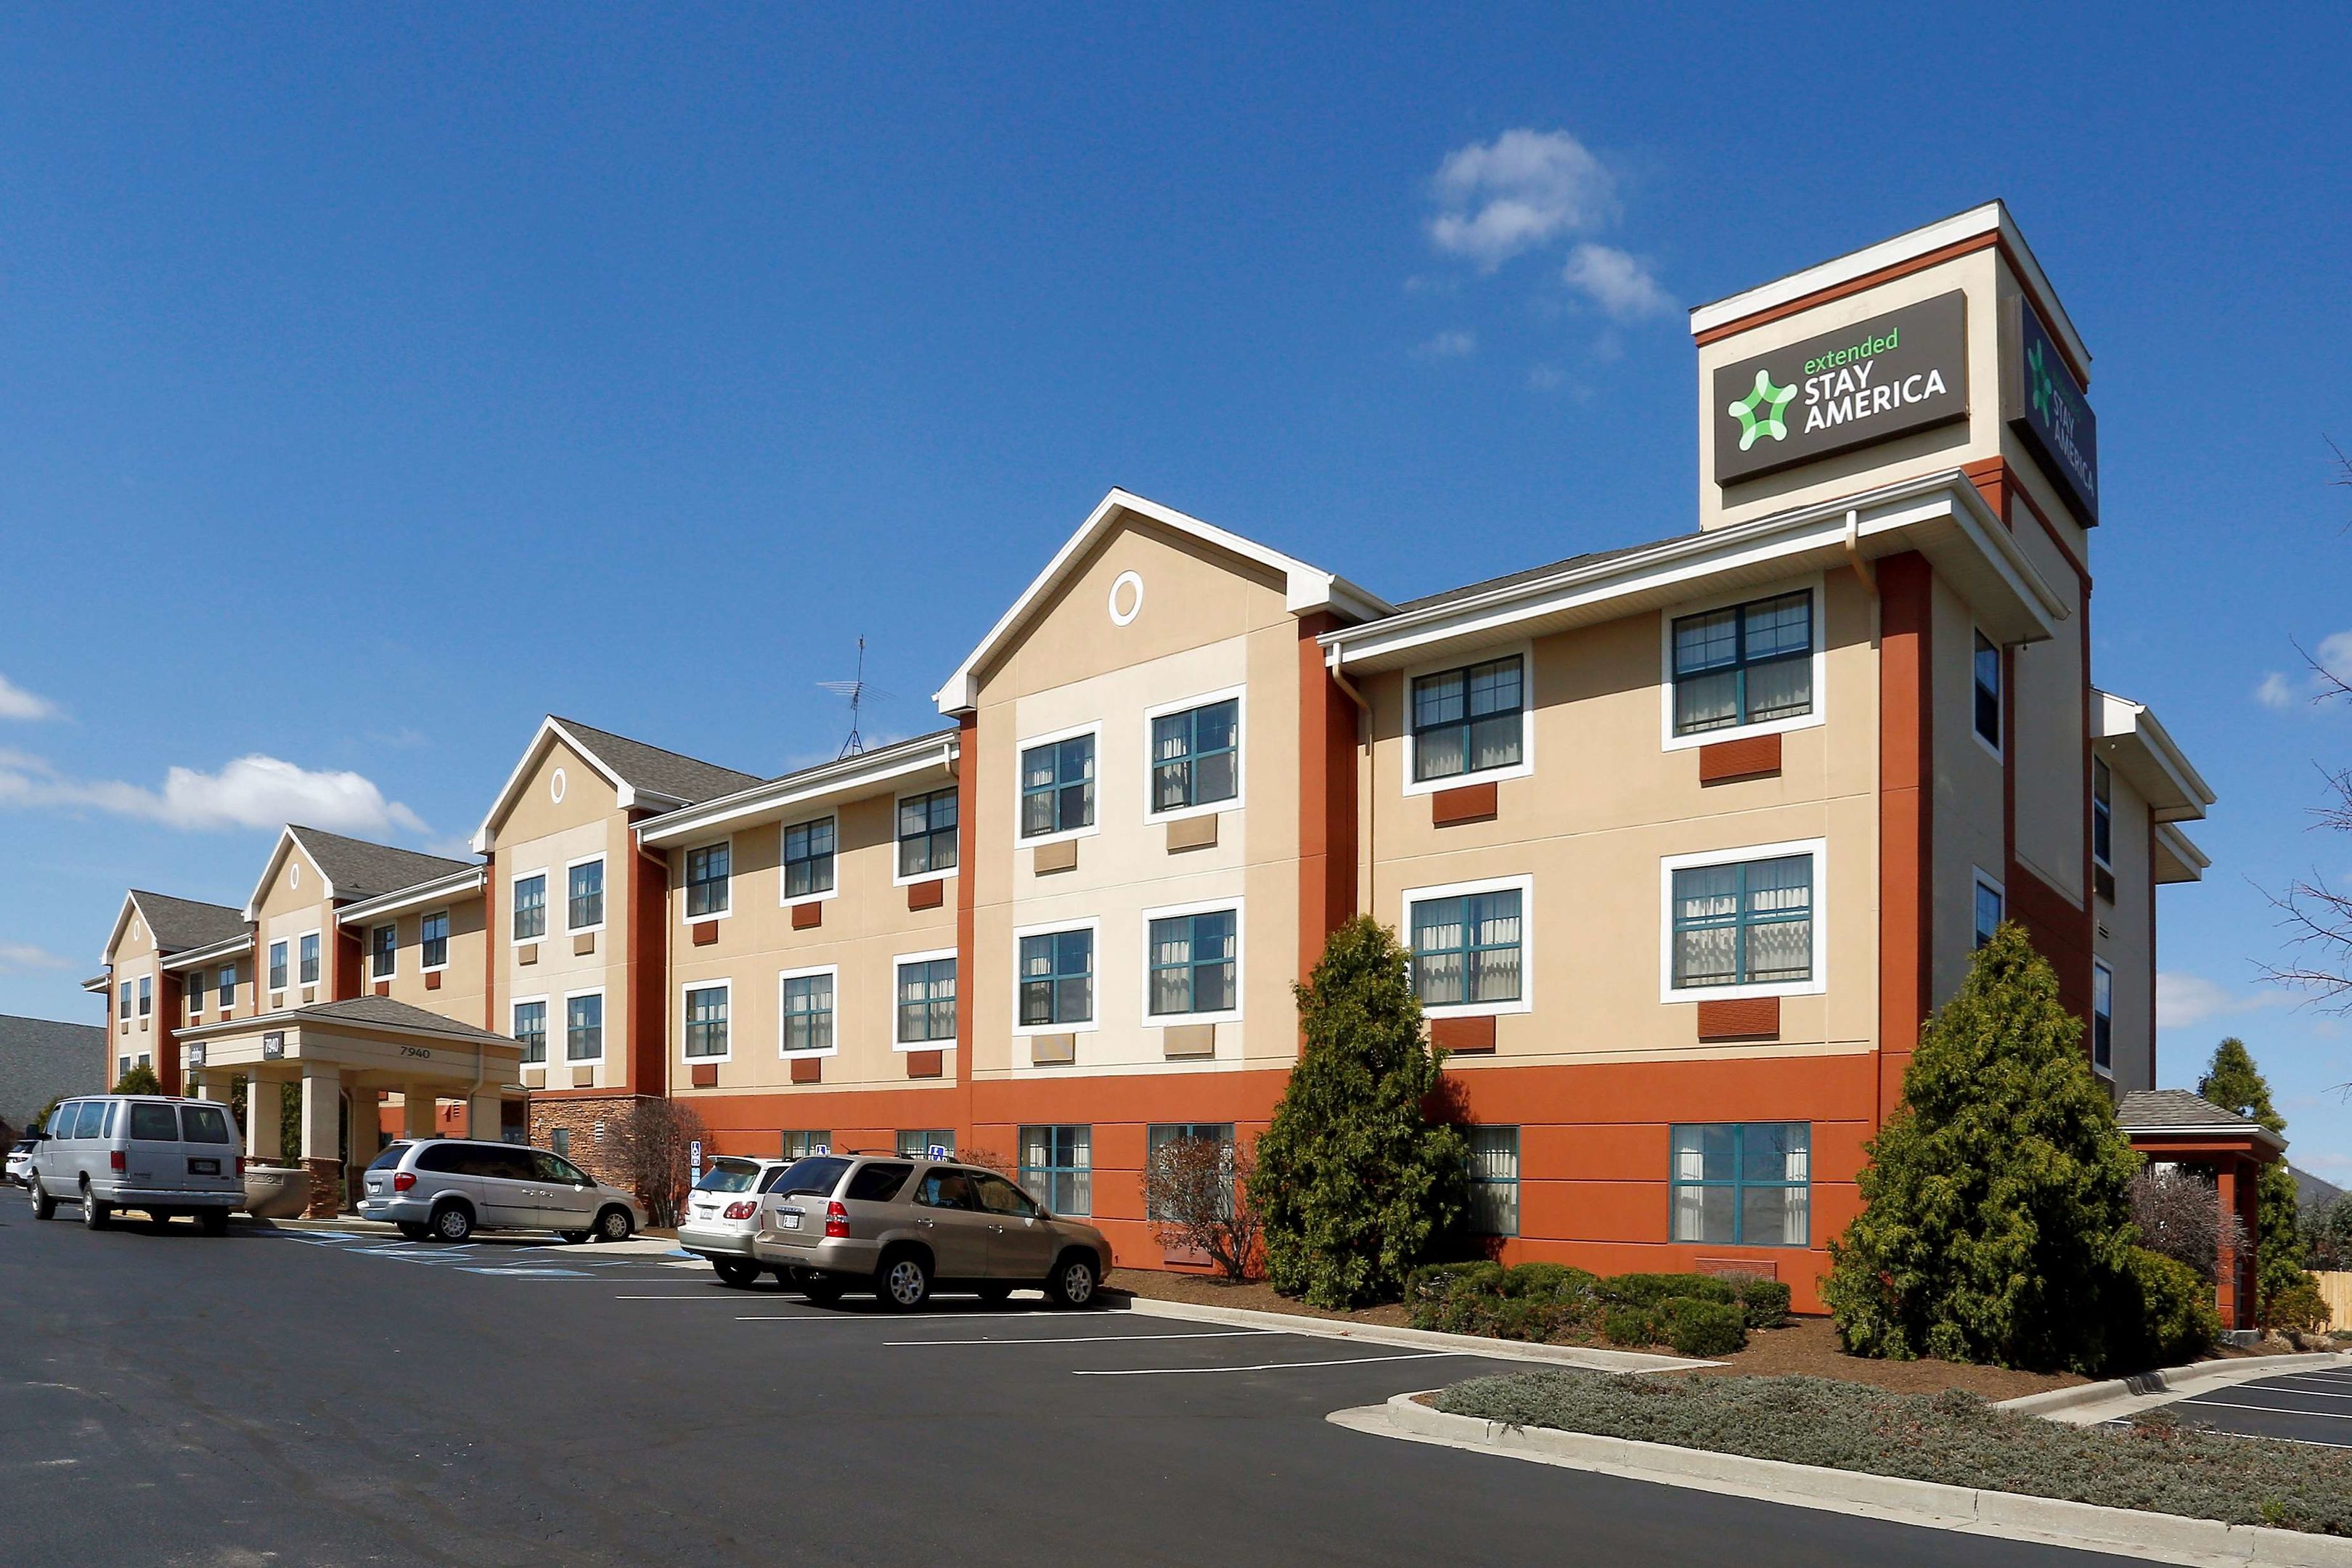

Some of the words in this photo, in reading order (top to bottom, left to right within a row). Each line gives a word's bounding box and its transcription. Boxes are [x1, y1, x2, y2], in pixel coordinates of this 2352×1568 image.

[1804, 327, 1899, 375] extended
[1804, 369, 1947, 434] AMERICA
[1805, 360, 1874, 405] STAY
[2053, 390, 2075, 438] STAY
[2054, 419, 2094, 497] AMERICA
[264, 1037, 279, 1053] 7940
[401, 1046, 430, 1058] 7940
